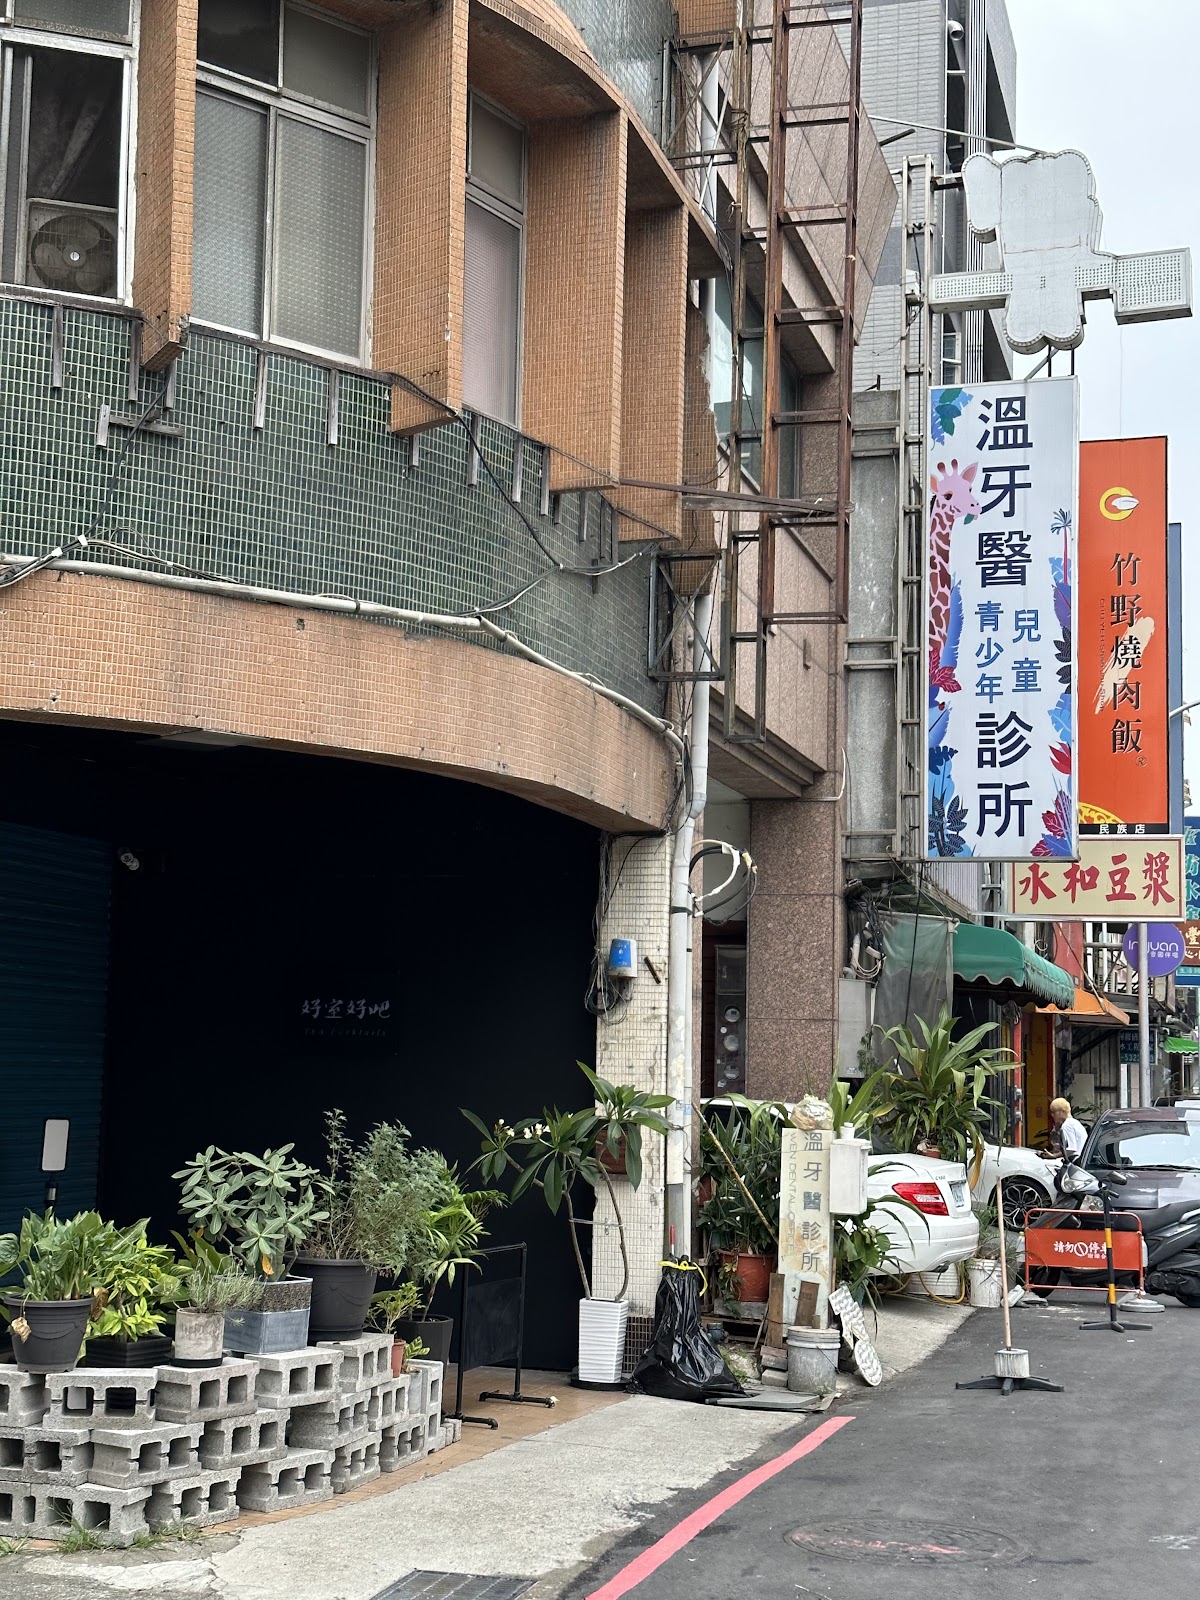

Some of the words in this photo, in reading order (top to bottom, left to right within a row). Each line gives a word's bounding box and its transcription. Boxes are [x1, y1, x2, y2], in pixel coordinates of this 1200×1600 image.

[975, 395, 1034, 588] 溫牙醫
[975, 601, 1004, 704] 青少年
[1011, 609, 1042, 693] 兒童
[1110, 552, 1142, 755] 竹野燒肉飯
[975, 711, 1033, 838] 診所
[1099, 823, 1146, 834] 民族店
[788, 1163, 797, 1206] DENTAL
[789, 1132, 798, 1160] WEN
[801, 1132, 823, 1273] 溫牙醫診所
